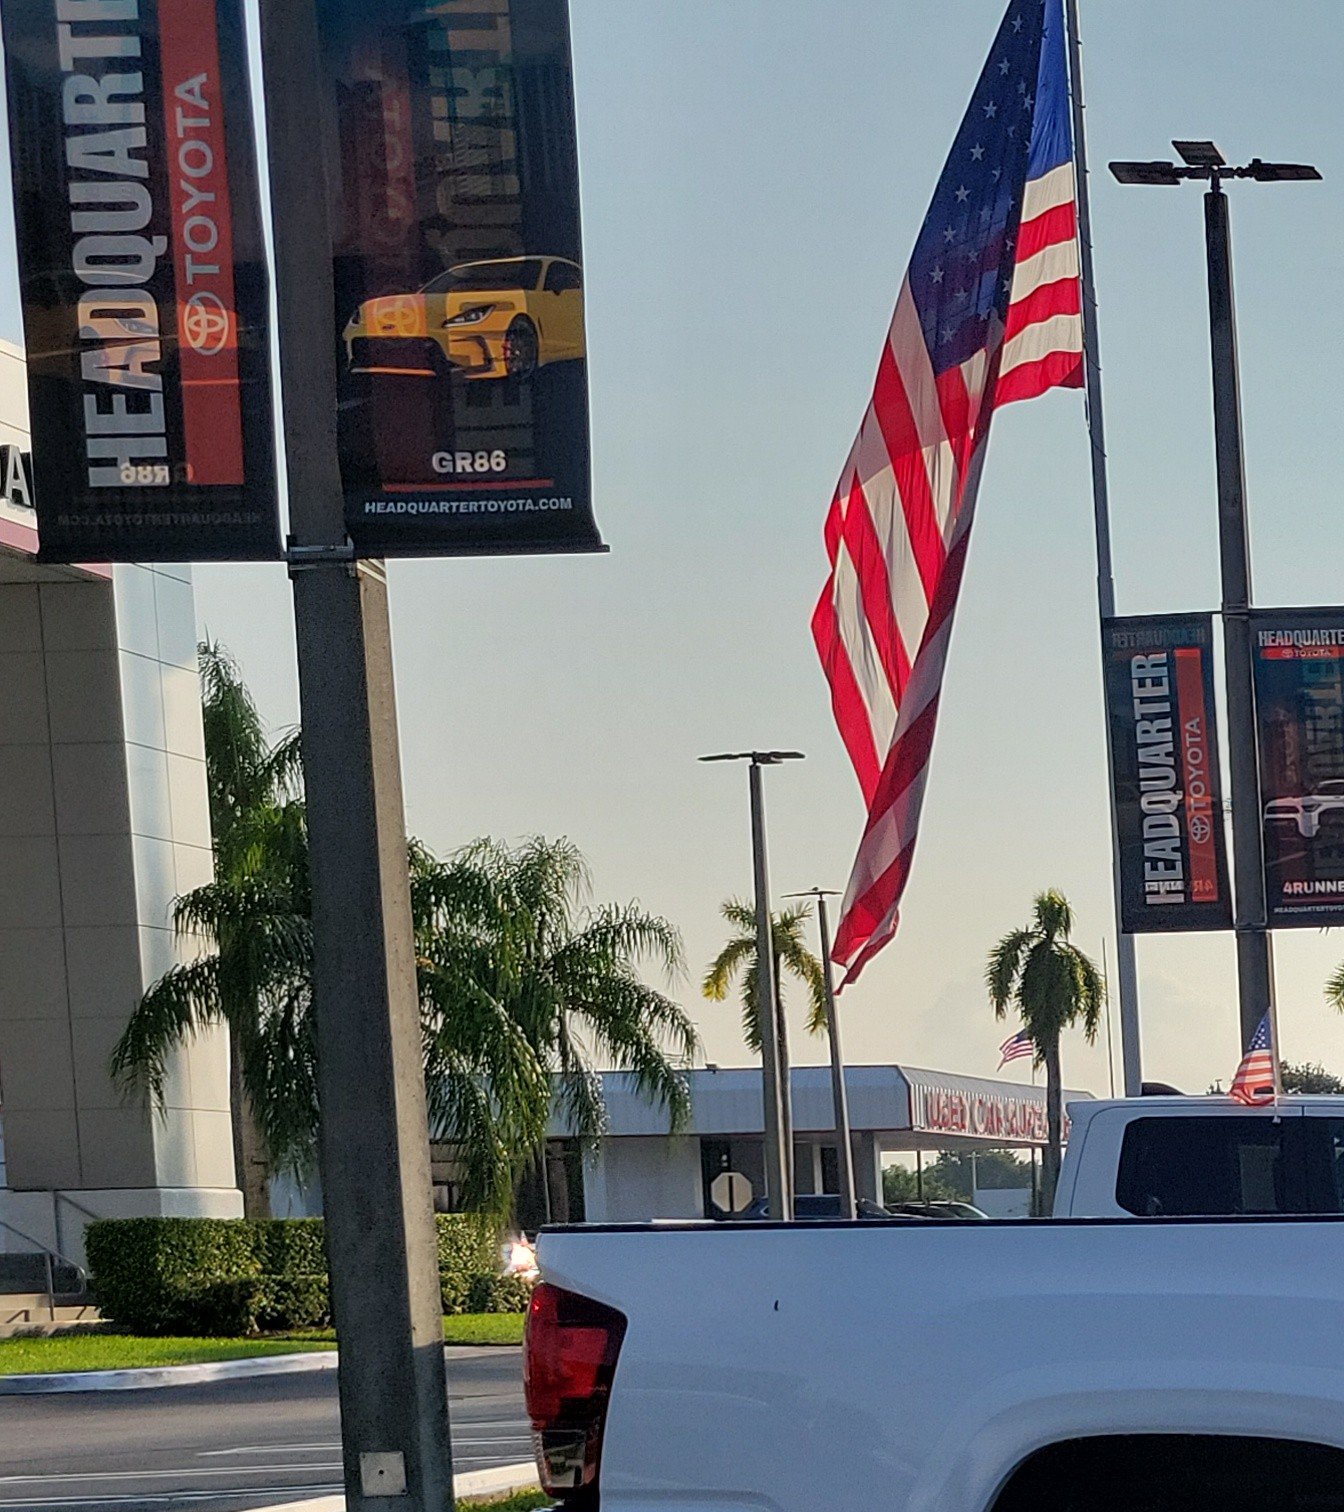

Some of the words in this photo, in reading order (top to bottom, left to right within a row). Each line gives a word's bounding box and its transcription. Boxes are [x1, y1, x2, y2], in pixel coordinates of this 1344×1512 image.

[174, 72, 222, 286] TOYOTA
[364, 498, 573, 516] HEADQUARTERTOYOTA.COM
[431, 449, 507, 474] GR86
[1131, 652, 1184, 904] HEADQUARTER
[1184, 717, 1206, 812] TOYOTA
